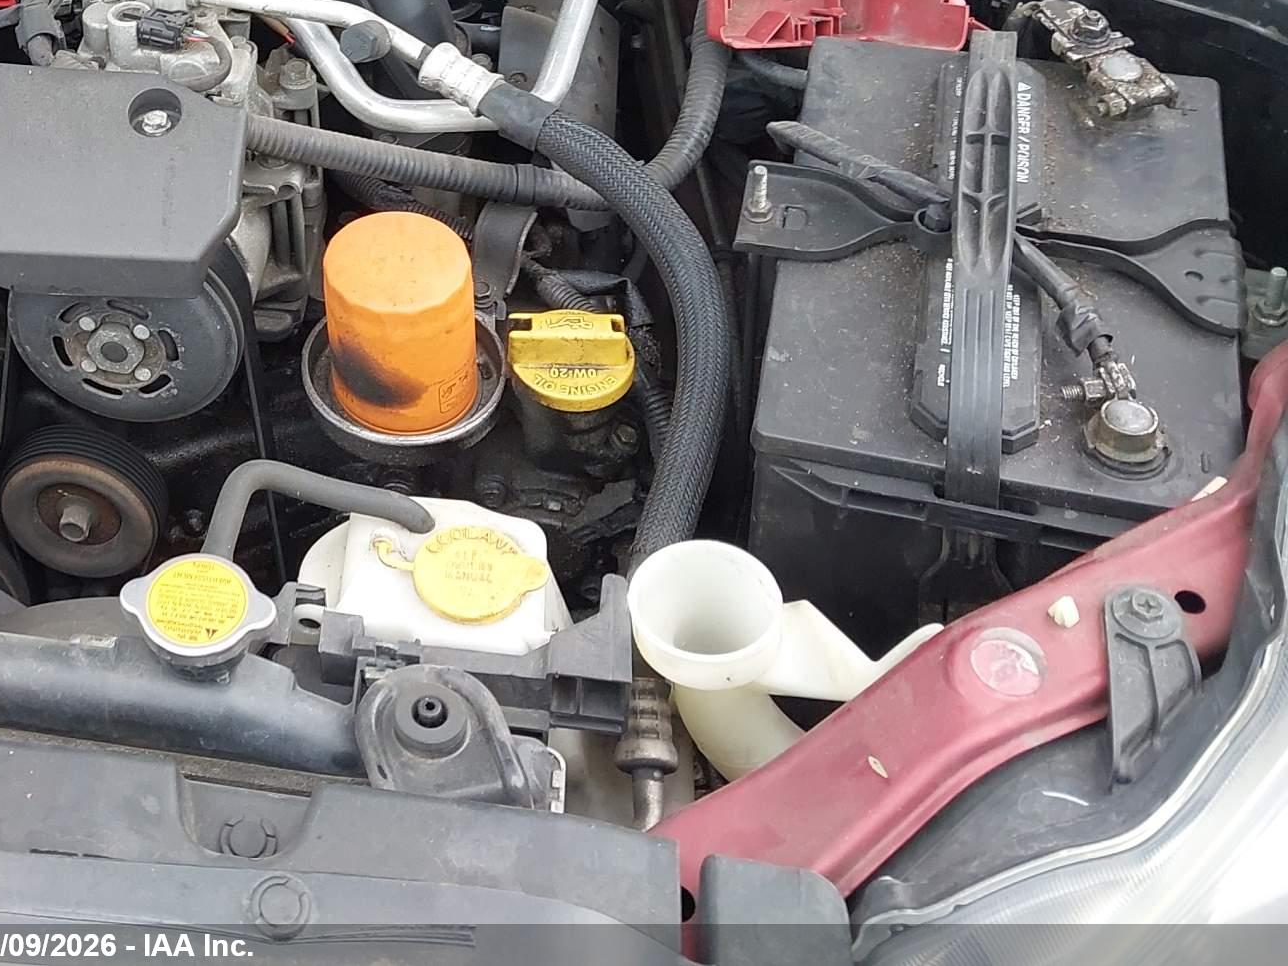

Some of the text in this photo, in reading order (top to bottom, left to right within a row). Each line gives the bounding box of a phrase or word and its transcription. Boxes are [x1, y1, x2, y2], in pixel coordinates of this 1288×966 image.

[1016, 93, 1031, 135] DANGER
[1016, 143, 1031, 183] POISON
[534, 375, 618, 396] ENGINE OIL
